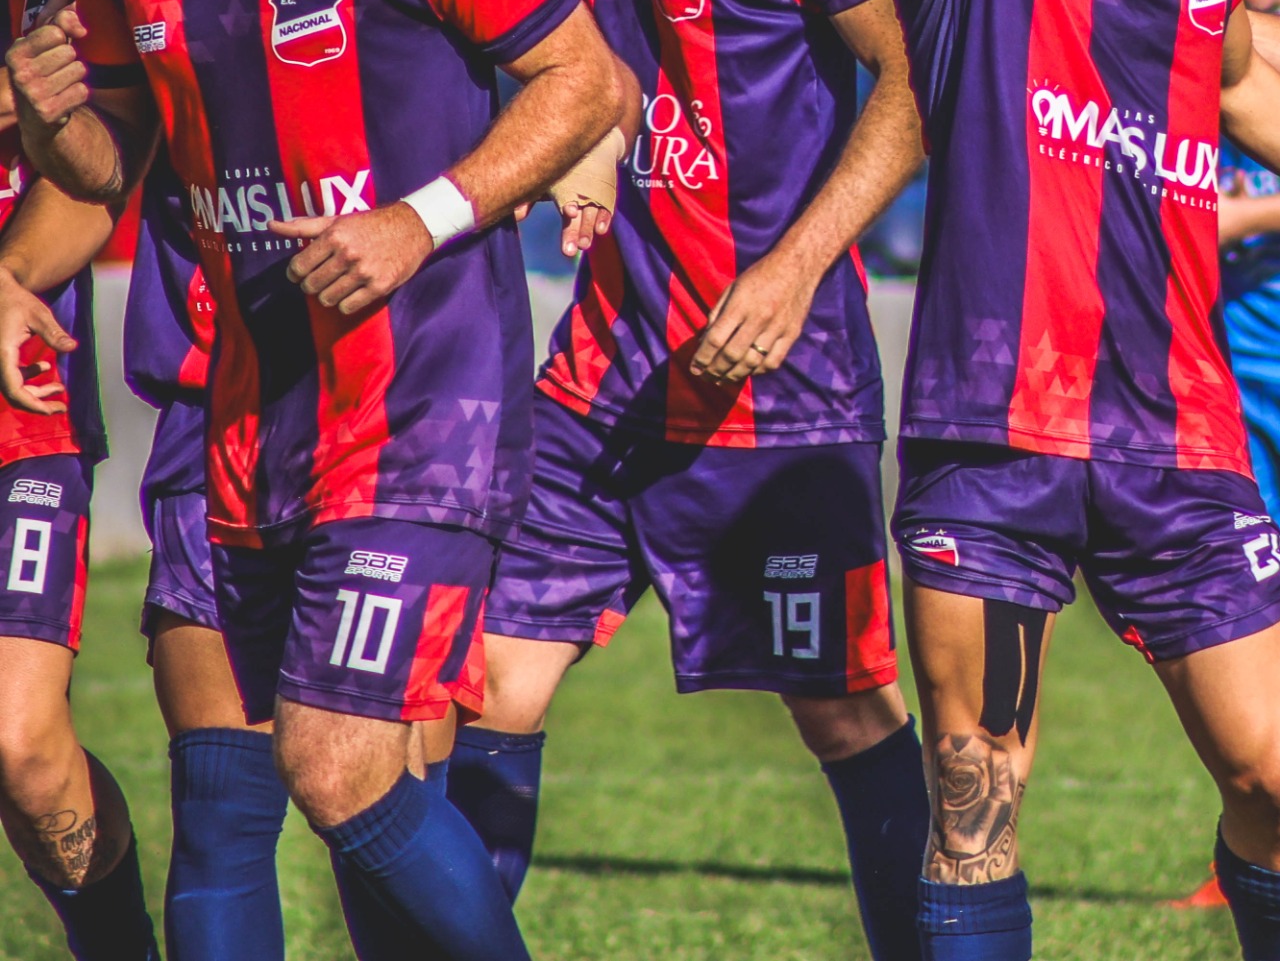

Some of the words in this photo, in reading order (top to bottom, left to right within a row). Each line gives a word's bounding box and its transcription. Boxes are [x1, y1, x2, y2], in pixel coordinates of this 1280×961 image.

[279, 14, 332, 37] NACIONAL
[643, 93, 681, 134] O
[1038, 91, 1148, 172] MAS
[1154, 132, 1219, 193] LUX
[624, 135, 719, 189] URA
[1039, 144, 1123, 173] ELÉTRICO
[225, 167, 271, 179] LOJAS
[193, 184, 274, 232] MAIS
[276, 169, 371, 222] LUX
[252, 242, 258, 251] E
[8, 494, 60, 508] SPORTS
[11, 479, 62, 499] SBE
[7, 518, 52, 594] 8
[348, 550, 408, 573] SBE
[766, 554, 818, 570] SBE
[344, 566, 402, 582] SPORTS
[329, 589, 402, 674] 10
[763, 591, 820, 658] 19
